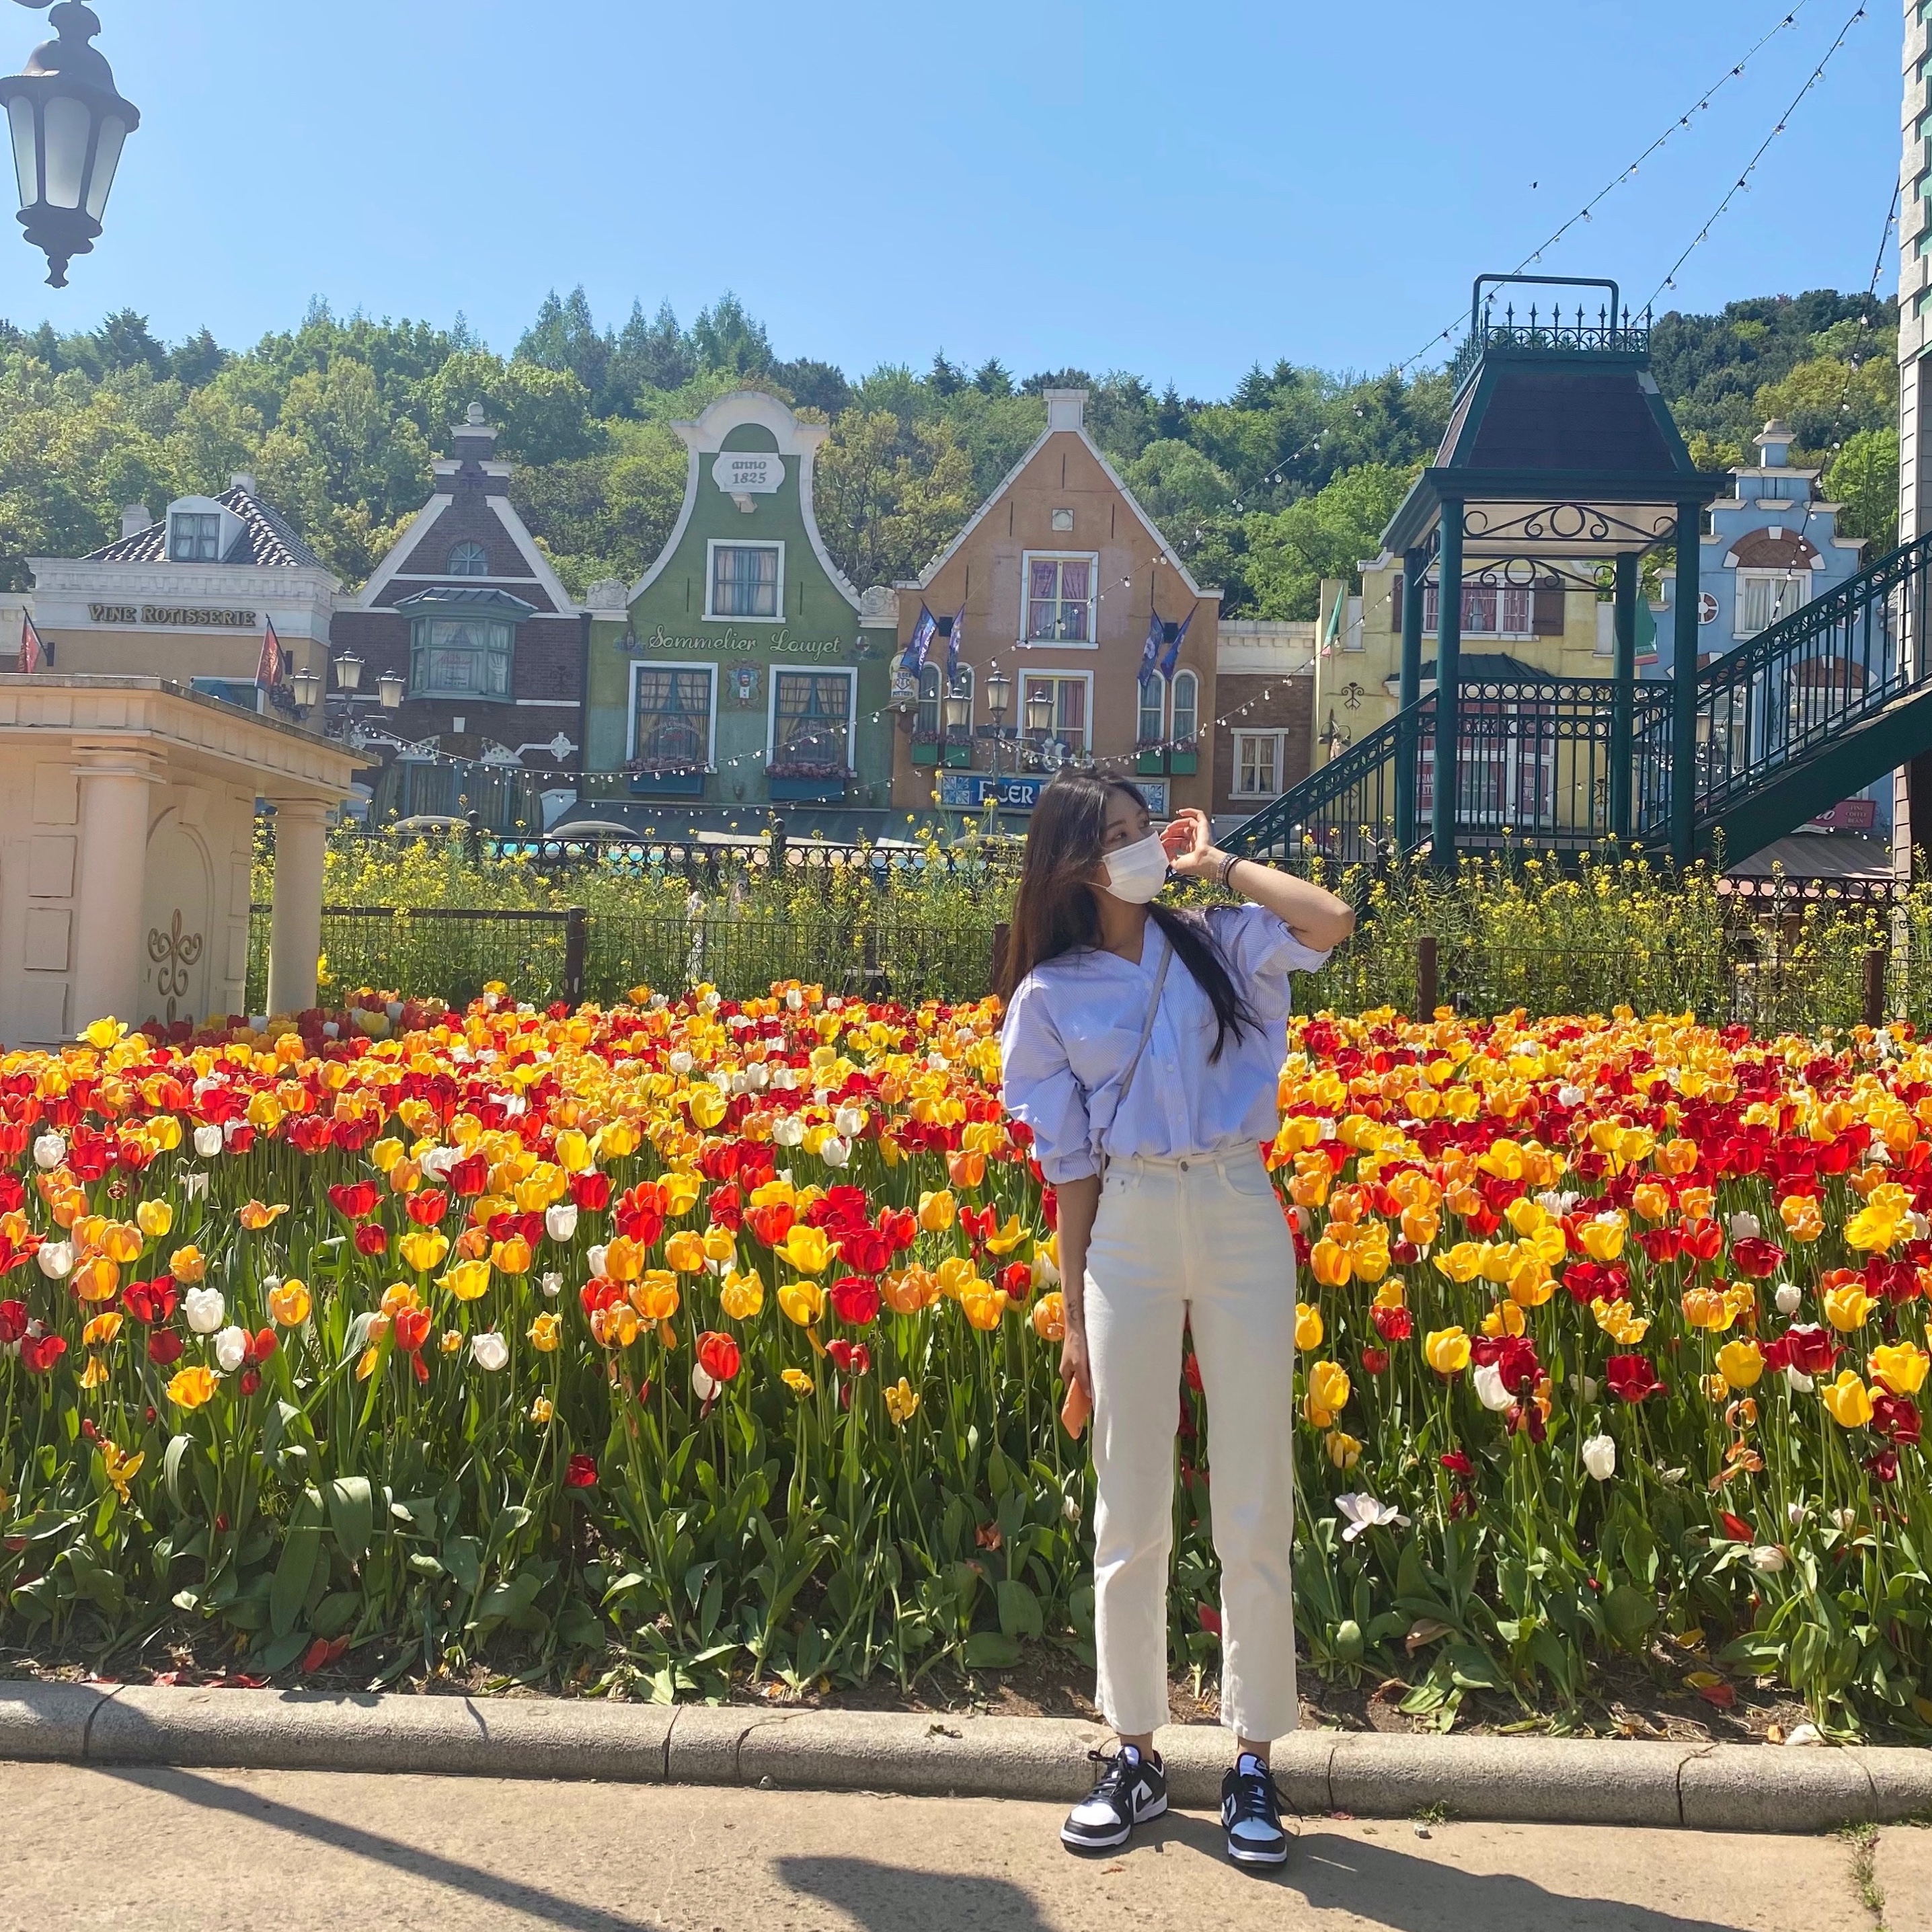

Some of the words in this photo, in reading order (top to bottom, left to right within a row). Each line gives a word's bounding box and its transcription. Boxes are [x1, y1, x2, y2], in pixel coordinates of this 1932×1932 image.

[732, 461, 767, 469] anno
[732, 471, 767, 484] 1825
[88, 604, 137, 623] VINE
[141, 605, 256, 627] ROTISSERIE
[648, 624, 757, 651] Sommelier
[769, 628, 841, 661] Louyet
